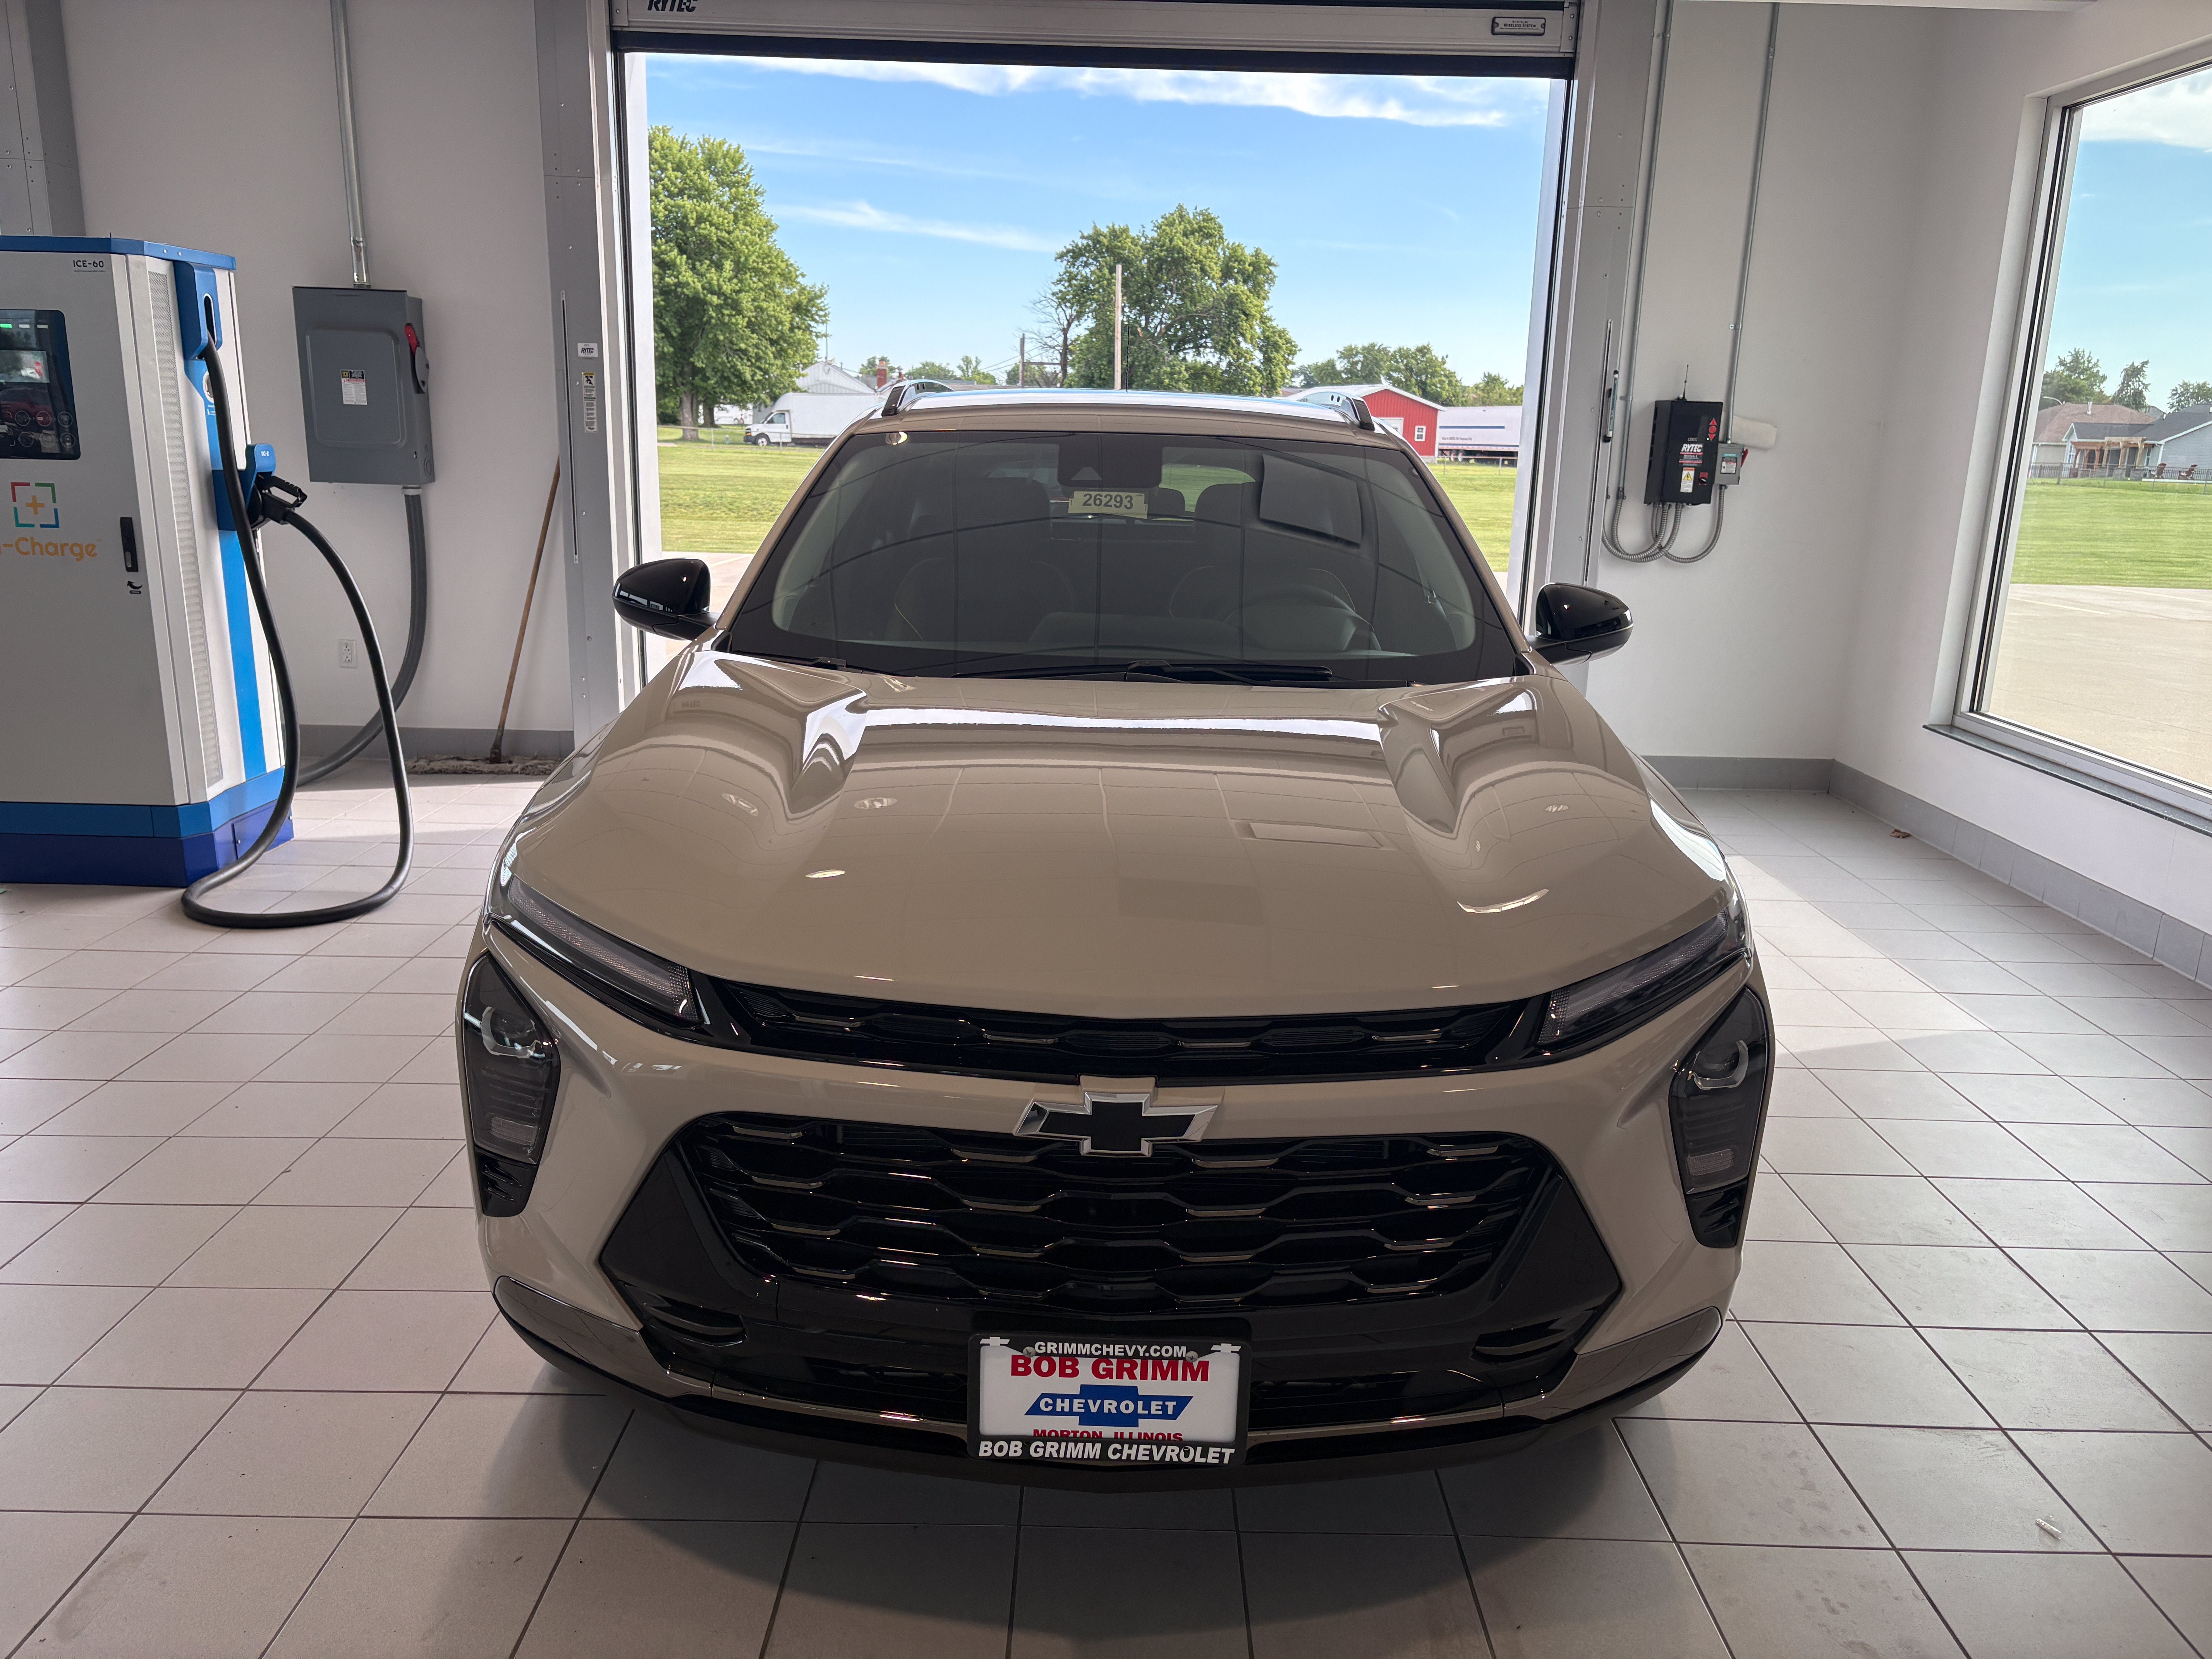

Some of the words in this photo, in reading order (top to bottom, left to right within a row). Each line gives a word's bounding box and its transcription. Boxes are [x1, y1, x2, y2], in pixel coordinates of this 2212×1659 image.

[647, 0, 696, 12] RYTEC
[1681, 443, 1703, 452] RYTEC
[1082, 493, 1133, 510] 26293
[0, 536, 98, 562] -Charge
[1034, 1341, 1187, 1357] GRIMMCHEVY.COM
[1011, 1354, 1080, 1378] BOB
[1091, 1358, 1209, 1382] GRIMM
[1039, 1398, 1176, 1415] CHEVROLET
[978, 1441, 1023, 1457] BOB
[1029, 1441, 1102, 1459] GRIMM
[1108, 1443, 1235, 1464] CHEVROLET
